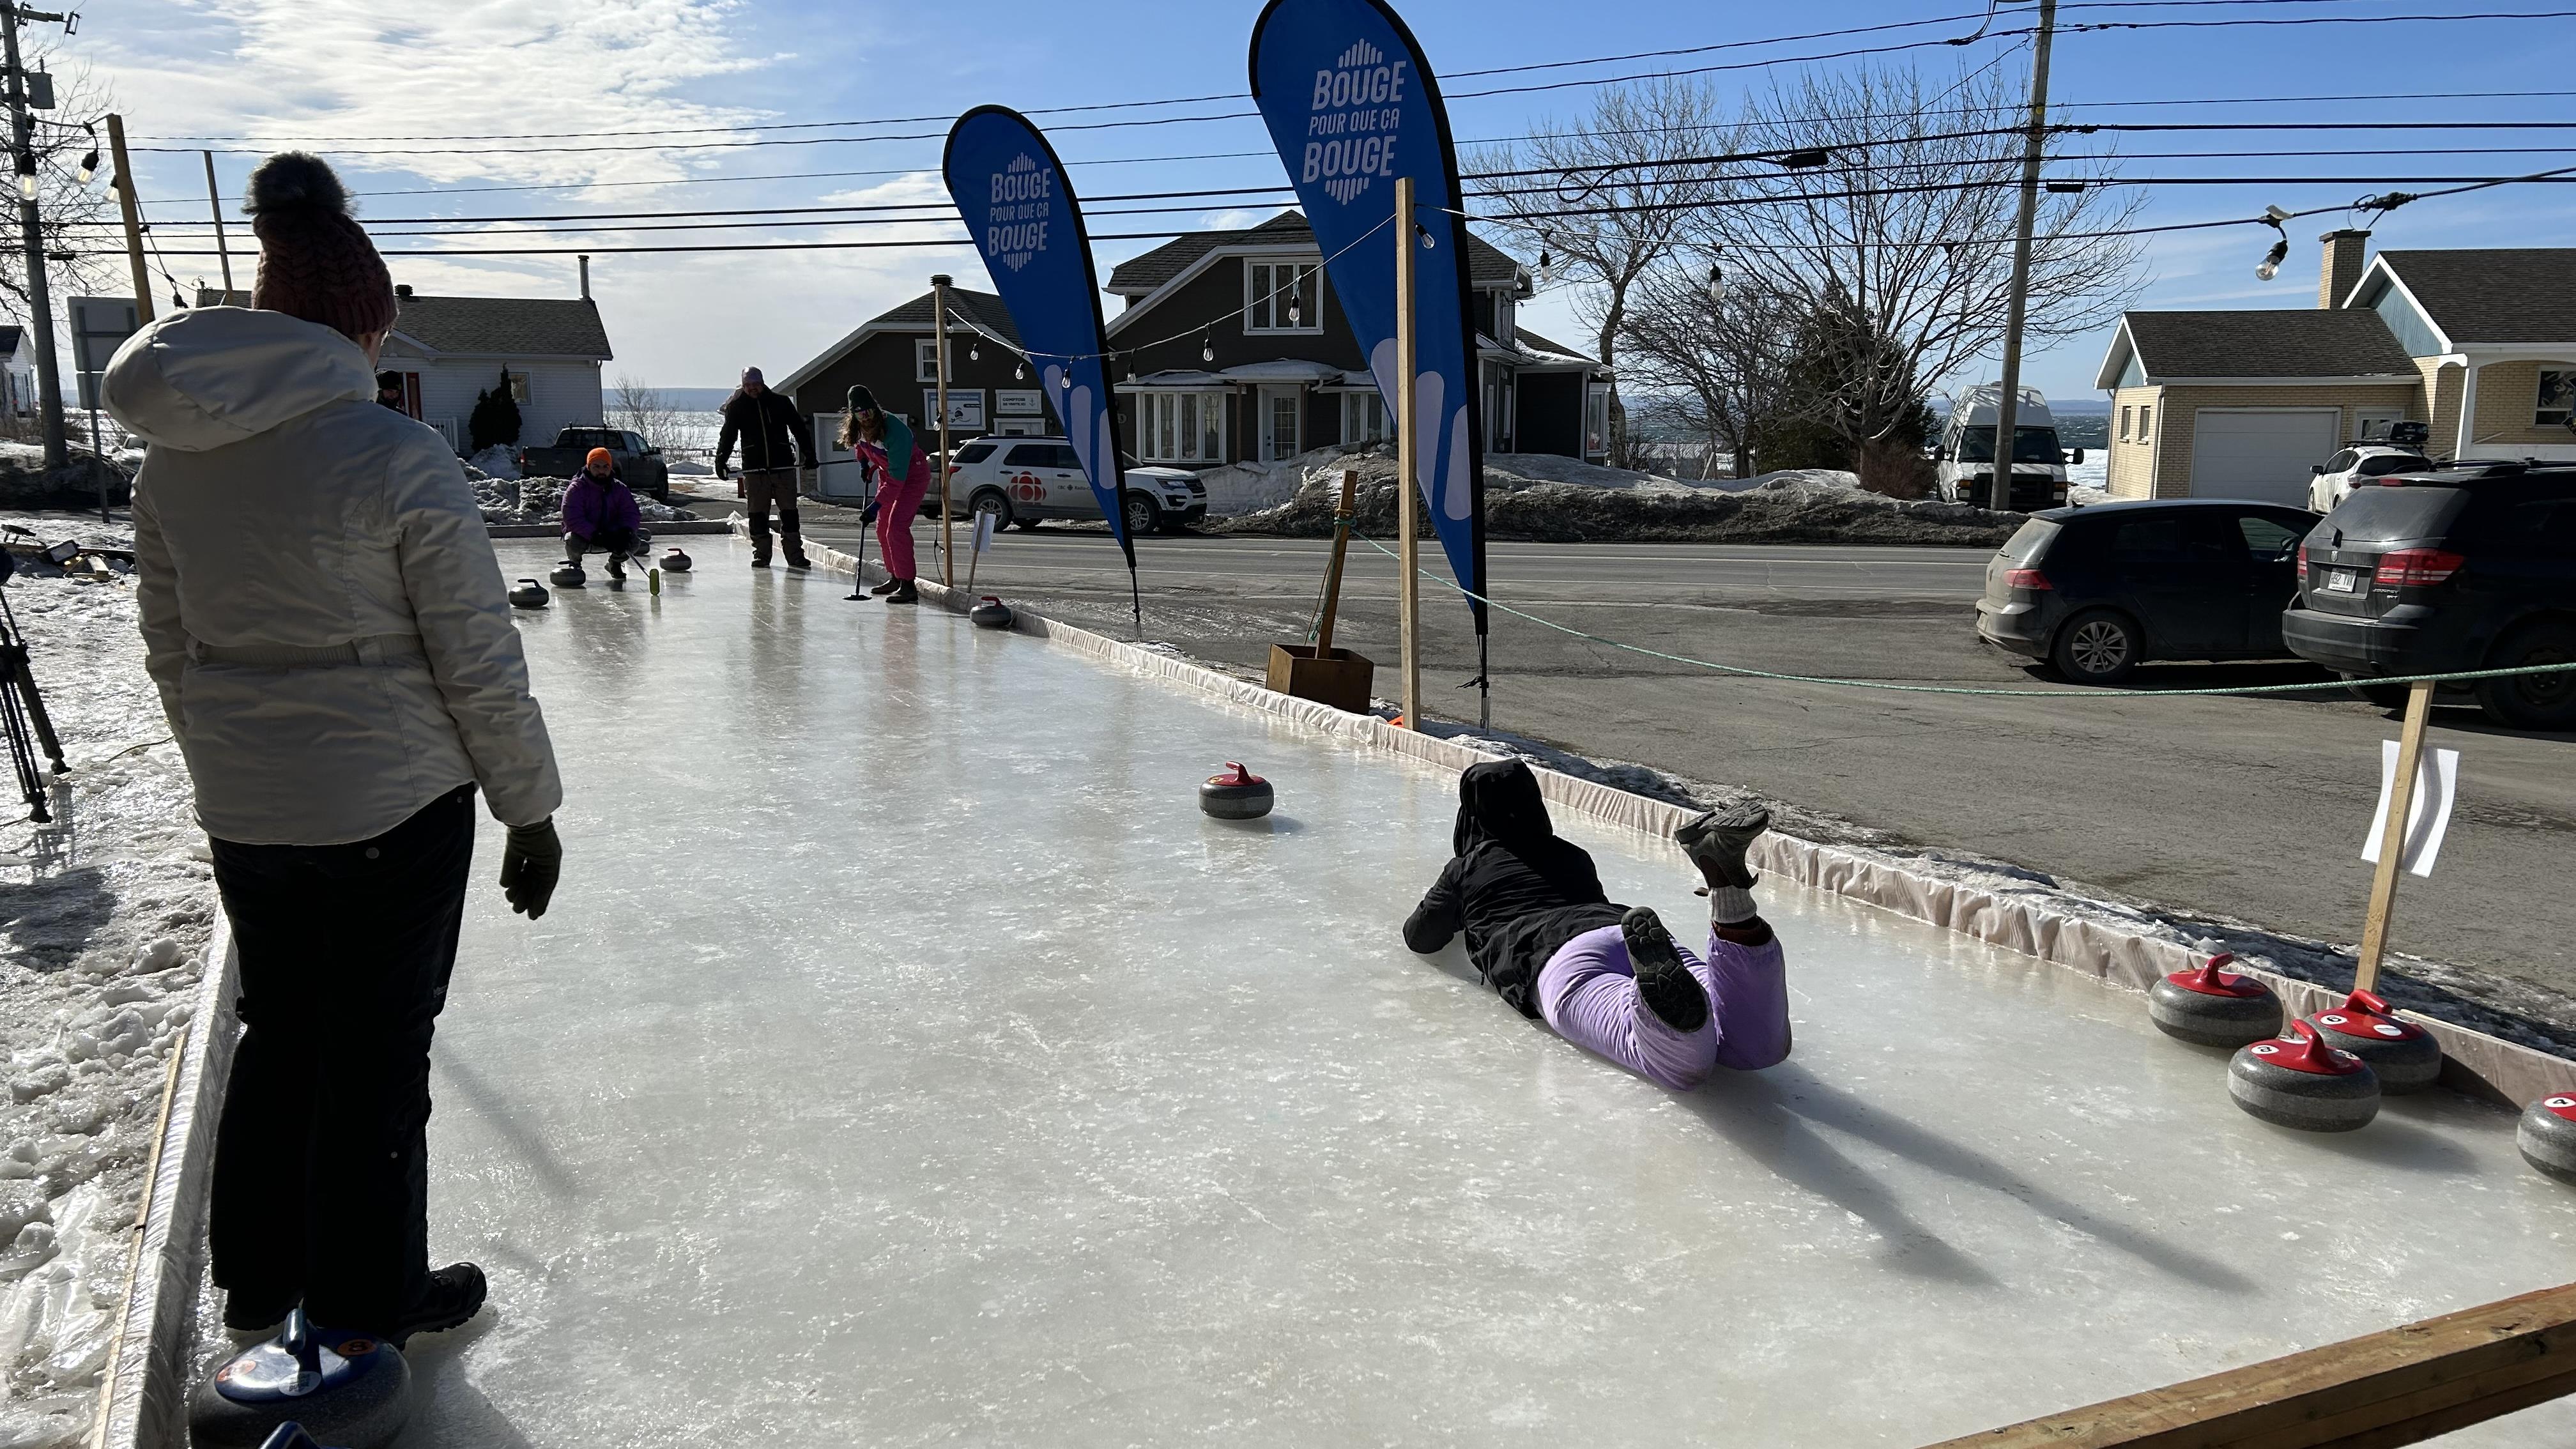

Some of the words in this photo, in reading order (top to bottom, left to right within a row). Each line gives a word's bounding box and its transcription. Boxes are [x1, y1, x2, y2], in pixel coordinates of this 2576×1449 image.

[1312, 61, 1406, 111] BOUGE
[1308, 112, 1347, 136] POUR
[1349, 109, 1377, 132] QUE
[1380, 108, 1400, 132] ÇA
[1302, 135, 1397, 183] BOUGE
[992, 167, 1051, 203] BOUGE
[990, 206, 1015, 222] POUR
[1018, 203, 1035, 220] QUE
[1037, 202, 1049, 219] ÇA
[988, 221, 1048, 256] BOUGE
[348, 1340, 369, 1352] 8
